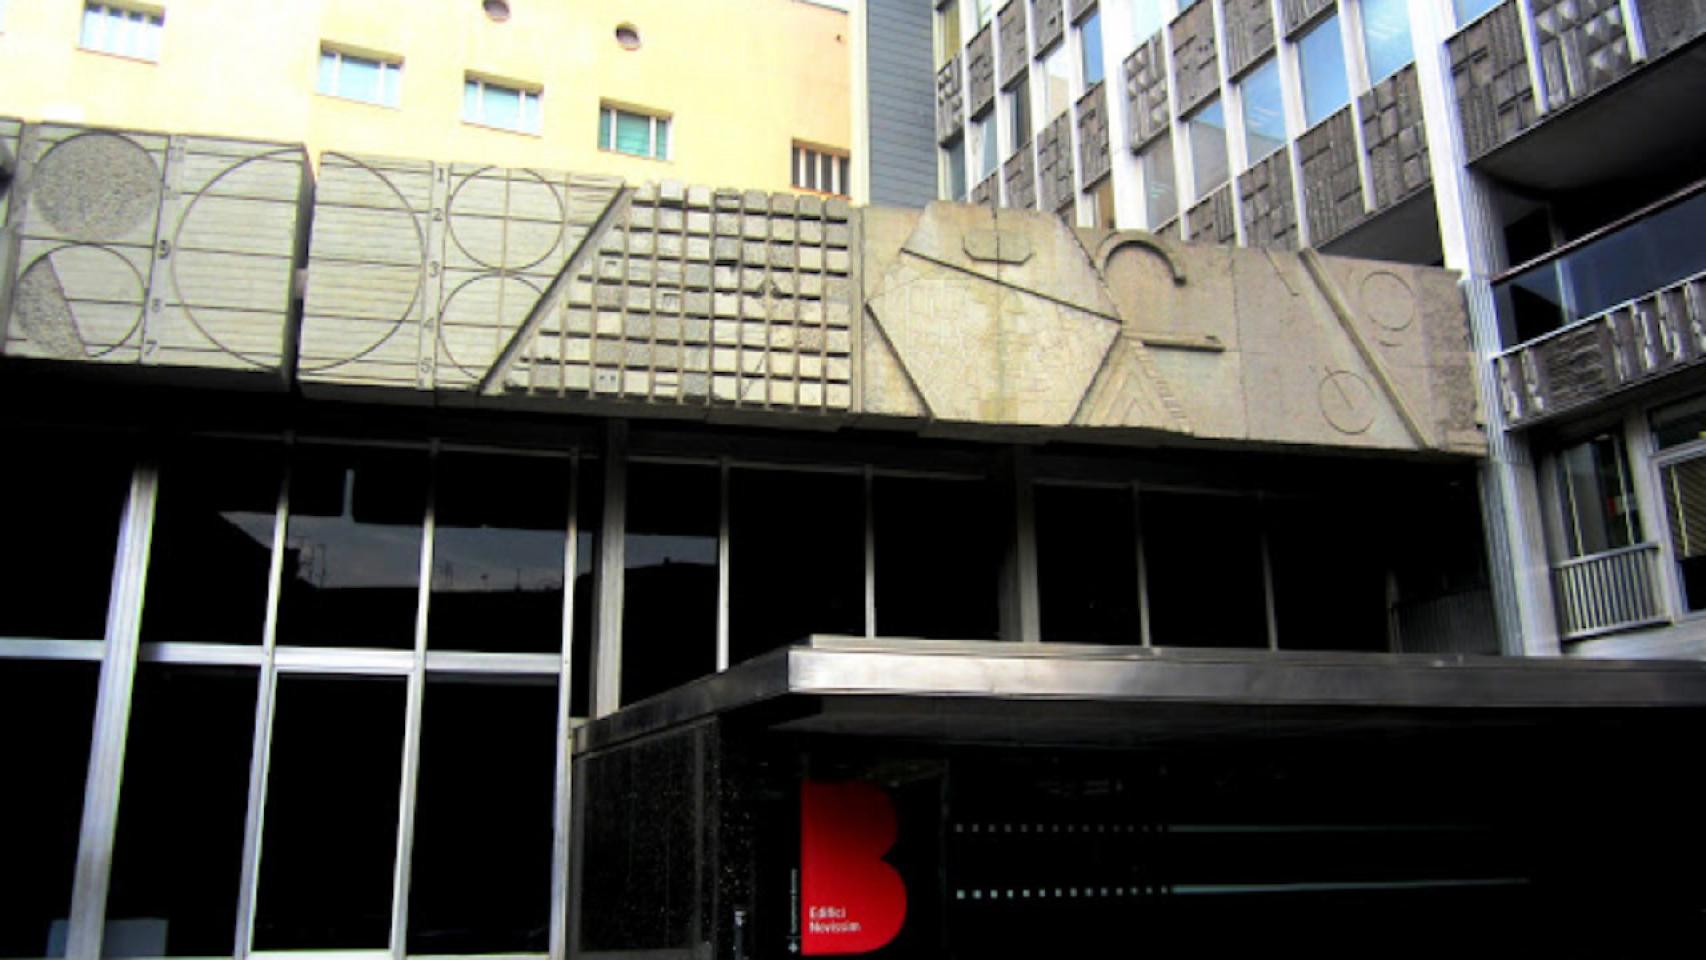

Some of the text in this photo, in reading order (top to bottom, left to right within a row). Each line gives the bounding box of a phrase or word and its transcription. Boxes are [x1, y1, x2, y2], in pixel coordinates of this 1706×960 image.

[432, 207, 444, 222] 2
[428, 261, 440, 278] 3
[808, 905, 847, 919] Edifici
